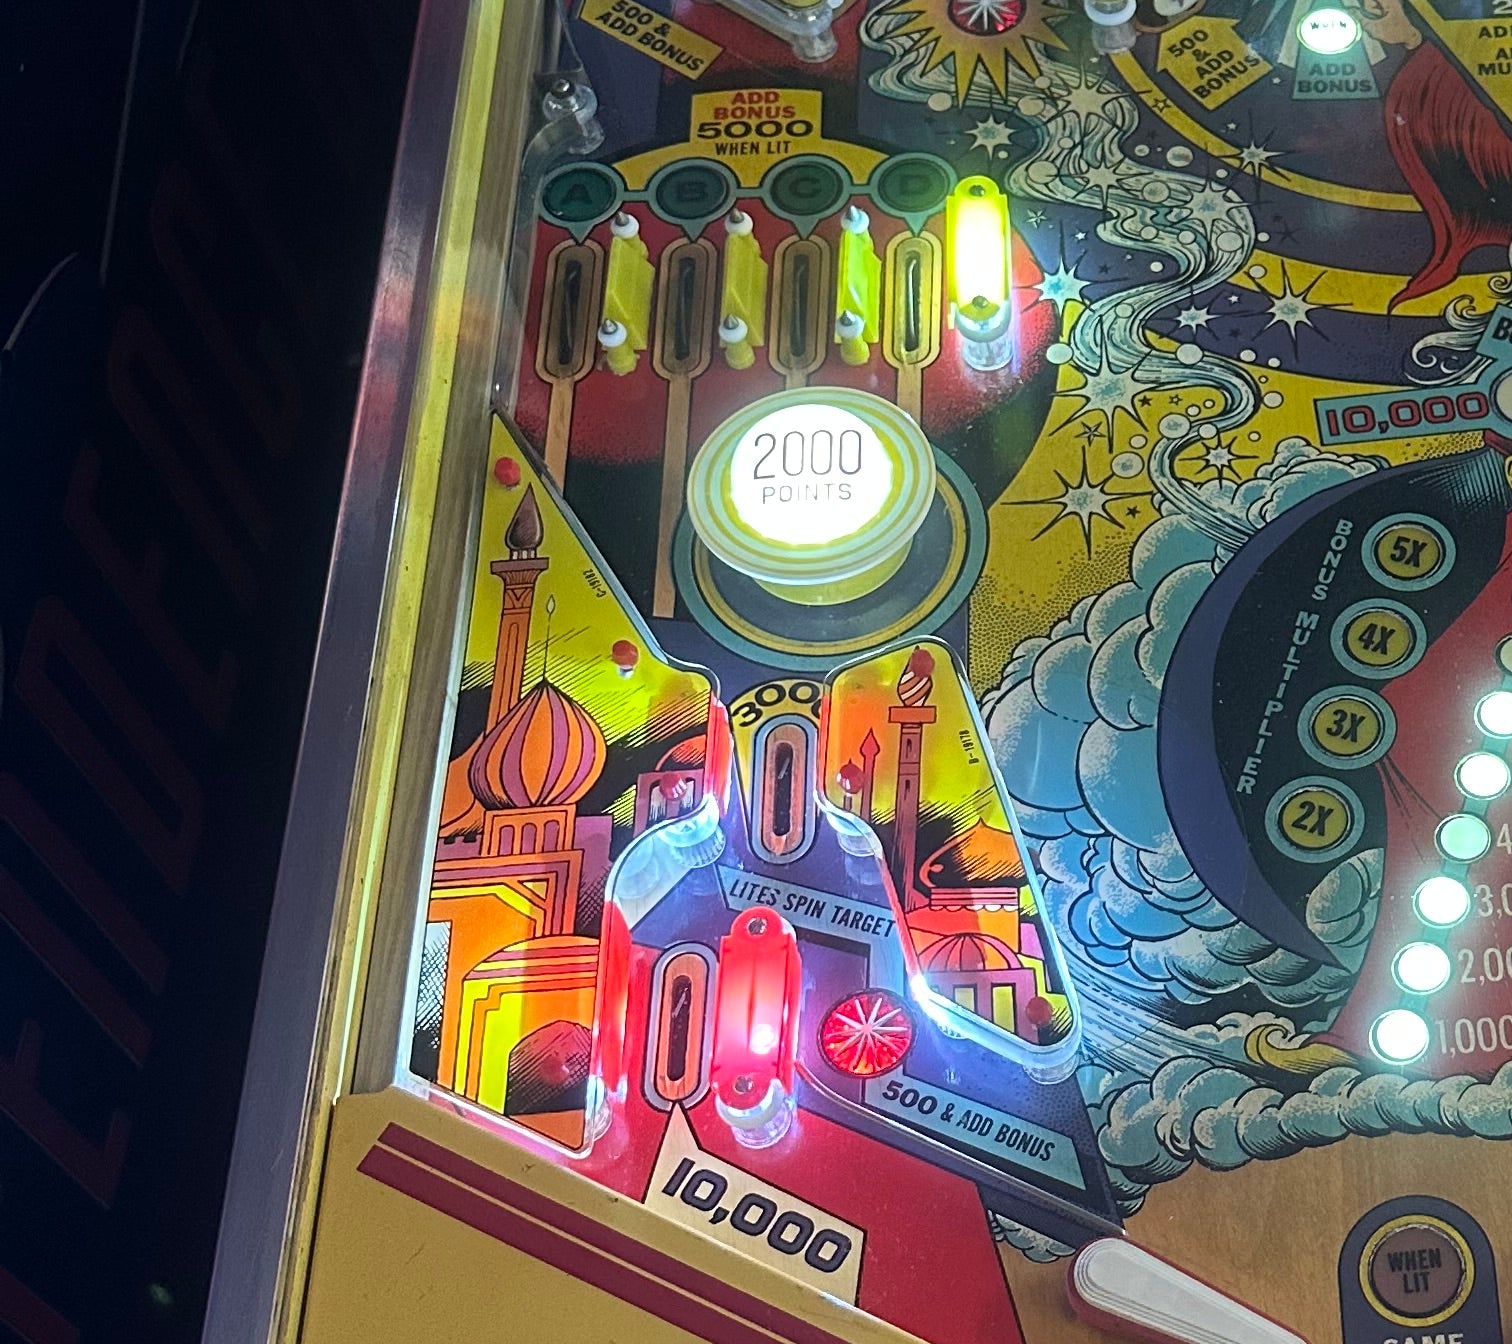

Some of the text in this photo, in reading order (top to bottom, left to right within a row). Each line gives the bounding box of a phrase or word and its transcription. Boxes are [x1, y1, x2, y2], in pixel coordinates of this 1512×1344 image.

[611, 0, 670, 39] 500 &
[596, 11, 705, 72] ADD BONUS
[1167, 29, 1209, 58] 500
[1192, 49, 1212, 63] &
[1193, 56, 1261, 100] BONUS
[1196, 49, 1235, 80] ADD
[1308, 63, 1356, 77] ADD
[732, 91, 781, 104] ADD
[1298, 79, 1372, 94] BONUS
[713, 104, 796, 119] BONUS
[697, 119, 814, 139] 5000
[715, 140, 792, 156] WHEN LIT
[1325, 392, 1490, 437] 10,000
[751, 429, 863, 481] 2000
[761, 482, 853, 506] POINTS
[1390, 536, 1426, 571] 5X
[1236, 518, 1354, 796] BONUS MULTIPLIER
[1357, 624, 1395, 657] 4X
[1327, 710, 1365, 745] 3X
[1294, 802, 1332, 835] 2X
[728, 881, 897, 940] LITES SPIN TARGET
[881, 1080, 1056, 1162] 500 & ADD BONUS
[660, 1158, 852, 1273] 10,000
[1387, 1247, 1443, 1274] WHEN
[1402, 1269, 1430, 1295] LIT
